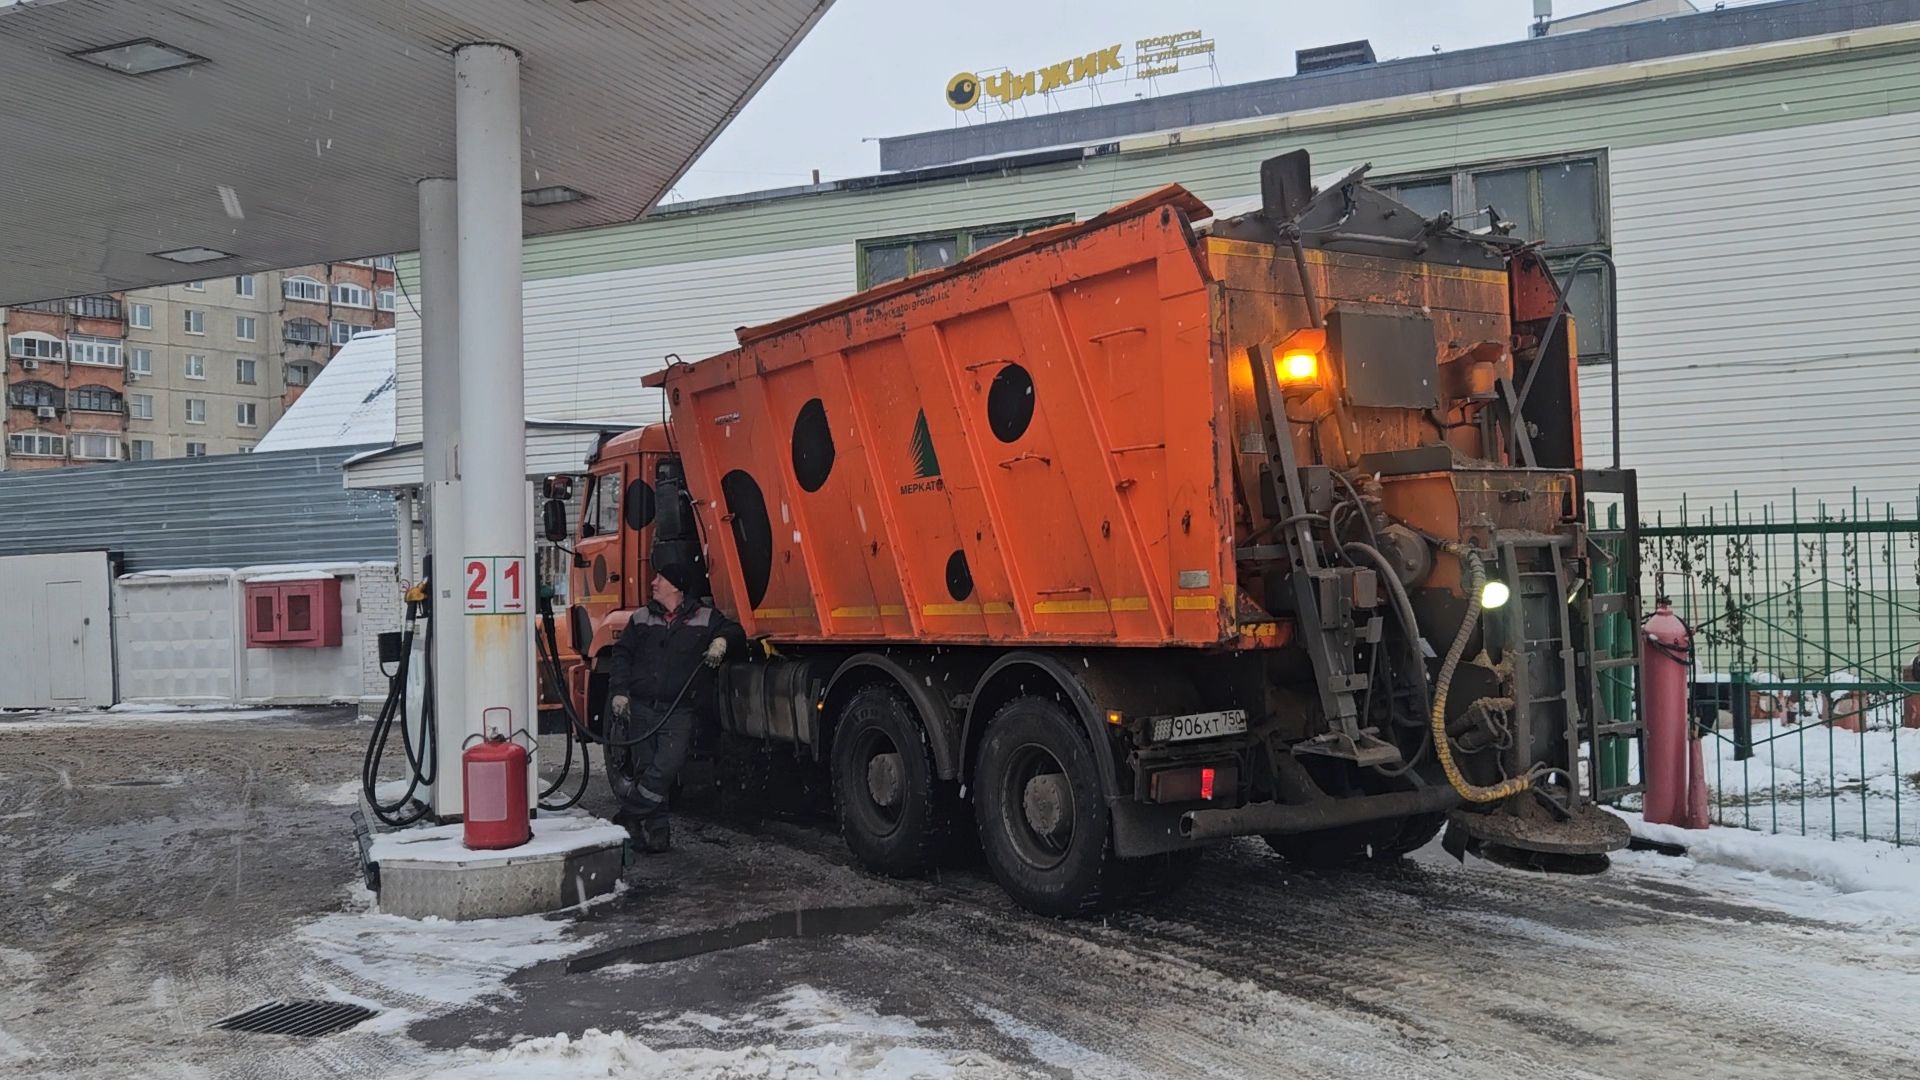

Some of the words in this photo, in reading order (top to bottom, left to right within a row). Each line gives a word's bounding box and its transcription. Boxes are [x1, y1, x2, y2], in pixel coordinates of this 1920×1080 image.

[1136, 30, 1202, 52] продукты
[467, 561, 487, 600] 2
[504, 561, 519, 599] 1
[1222, 711, 1242, 726] 750
